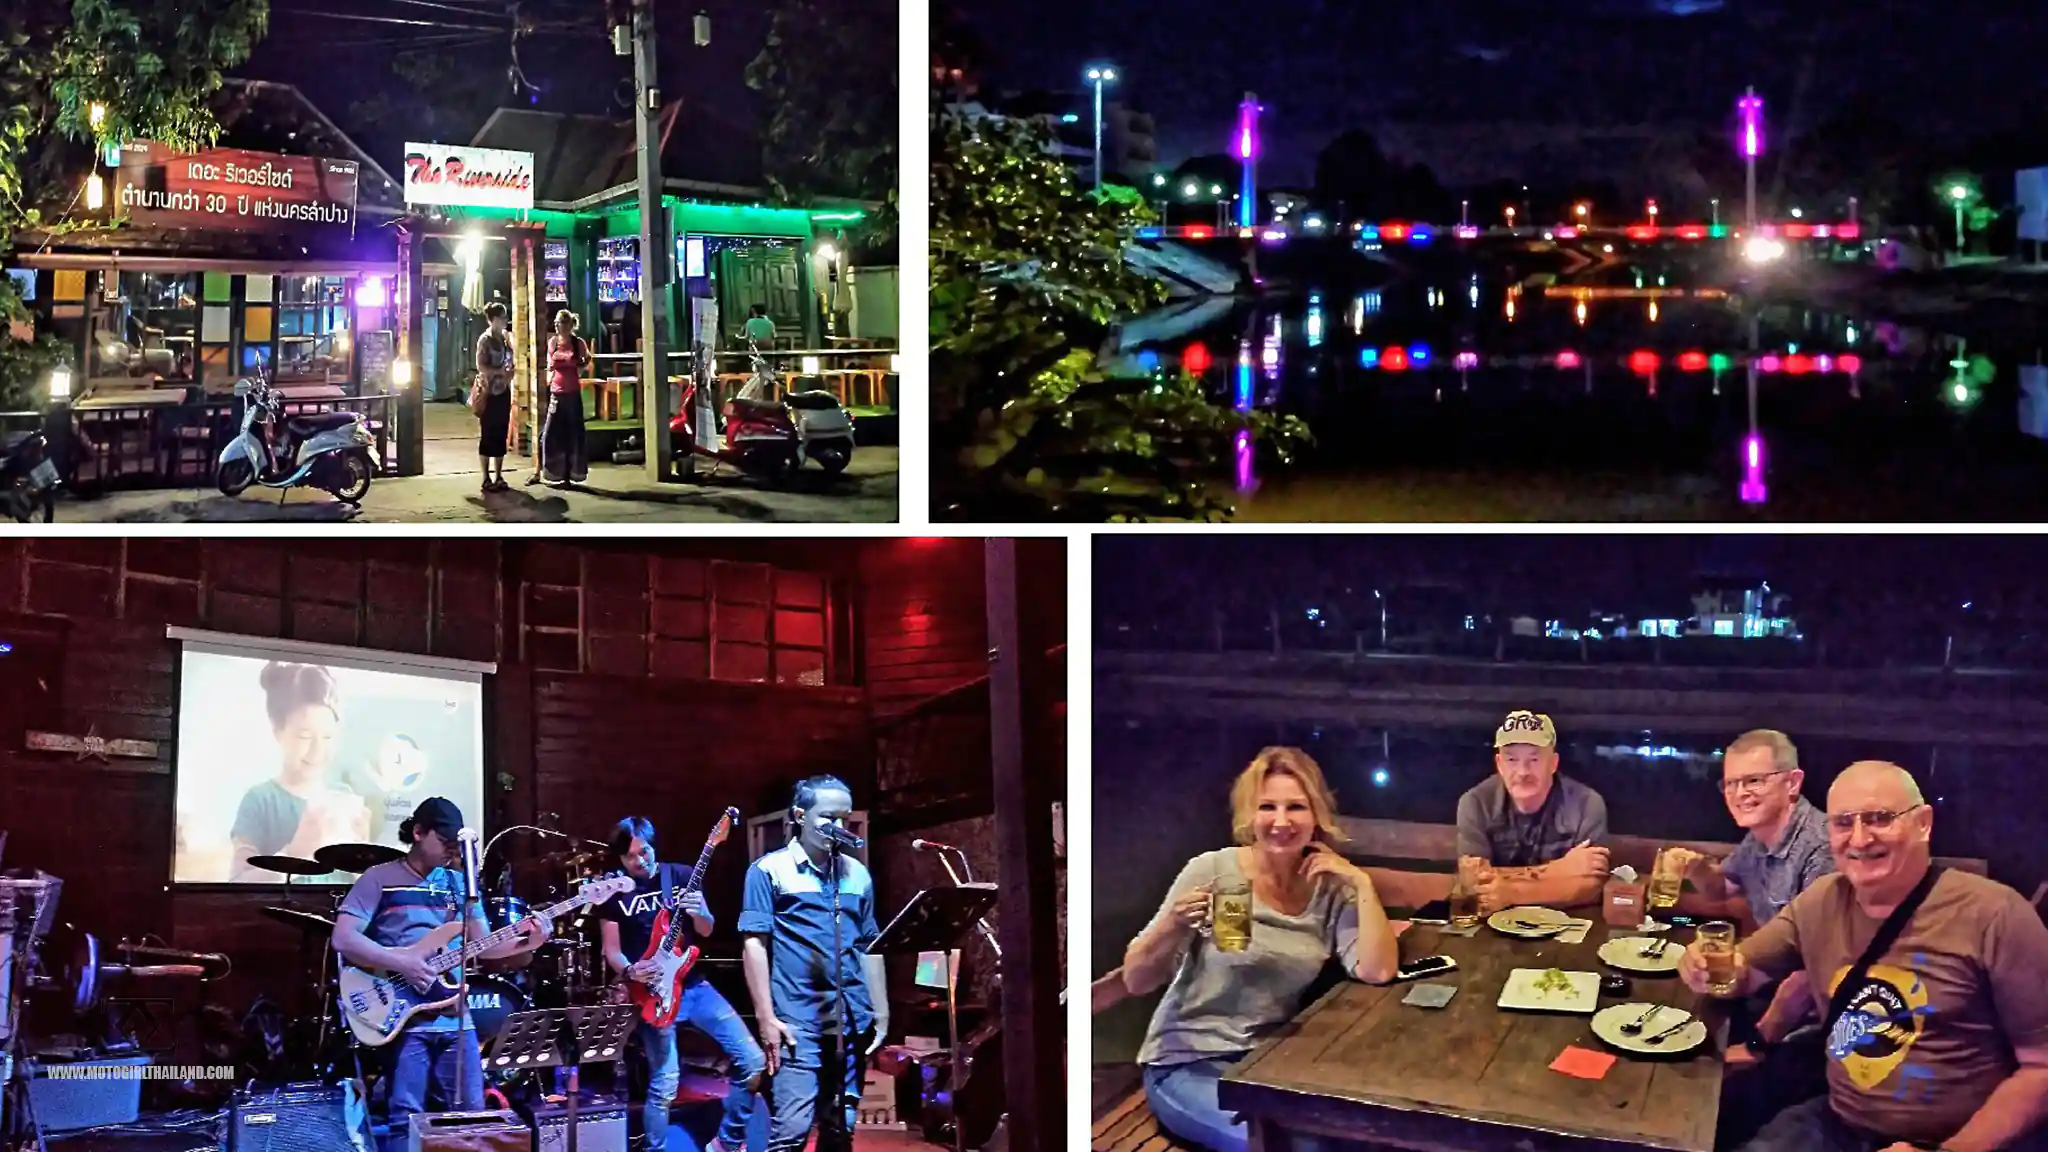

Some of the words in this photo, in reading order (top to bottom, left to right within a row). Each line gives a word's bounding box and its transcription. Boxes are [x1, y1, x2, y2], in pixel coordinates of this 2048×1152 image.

[188, 162, 221, 181] เดอะ
[225, 162, 293, 189] ริเวอร์ไซด์
[445, 156, 531, 191] Riverside
[121, 182, 200, 212] ตำนานกว่า
[205, 193, 226, 213] 30
[237, 194, 249, 216] ปี
[254, 196, 348, 223] แห่งนครลำปาง
